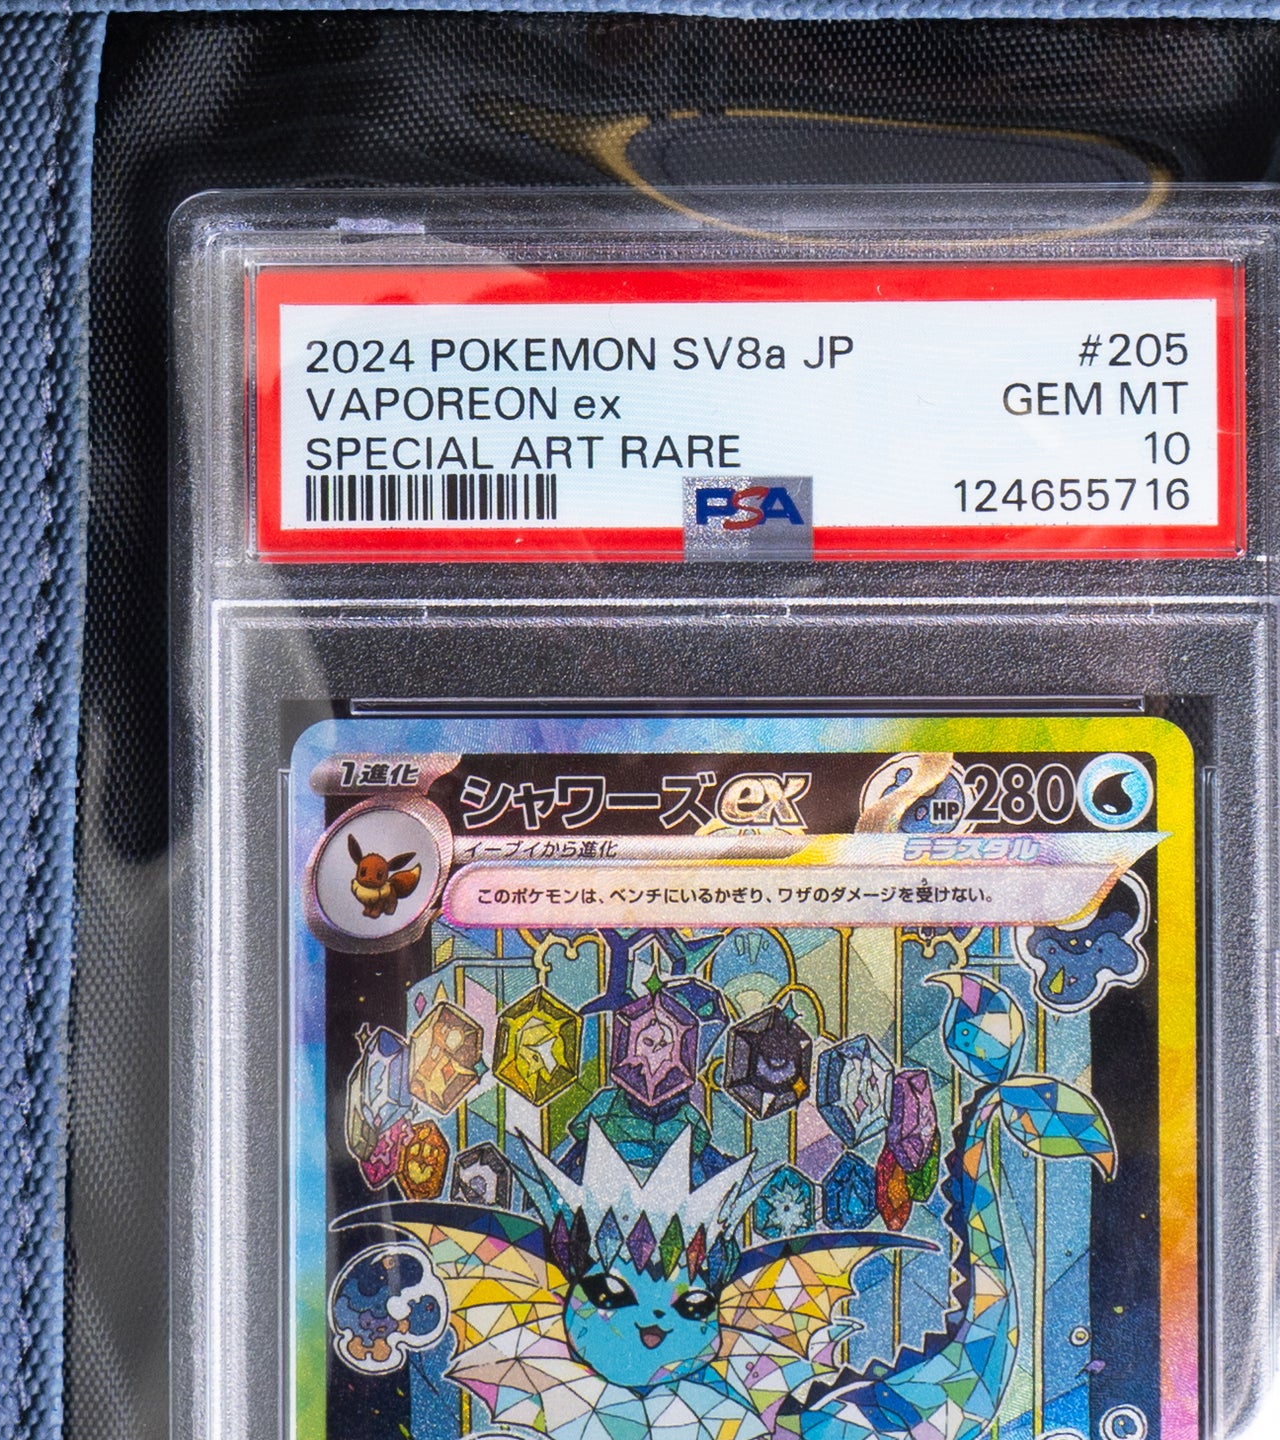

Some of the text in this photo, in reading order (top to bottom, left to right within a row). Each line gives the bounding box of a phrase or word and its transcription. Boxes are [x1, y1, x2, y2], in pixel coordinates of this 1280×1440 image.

[306, 336, 855, 373] 2024 POKEMON SV8a JP
[1079, 333, 1189, 367] #205
[306, 387, 622, 421] VAPOREON ex
[1002, 381, 1189, 417] GEM MT
[306, 435, 742, 471] SPECIAL ART RARE
[1145, 431, 1191, 465] 10
[695, 485, 804, 531] PSA
[953, 478, 1191, 513] 124655716
[339, 760, 420, 788] 1進化
[931, 762, 1079, 825] HP 280
[903, 837, 1044, 861] テラスタル
